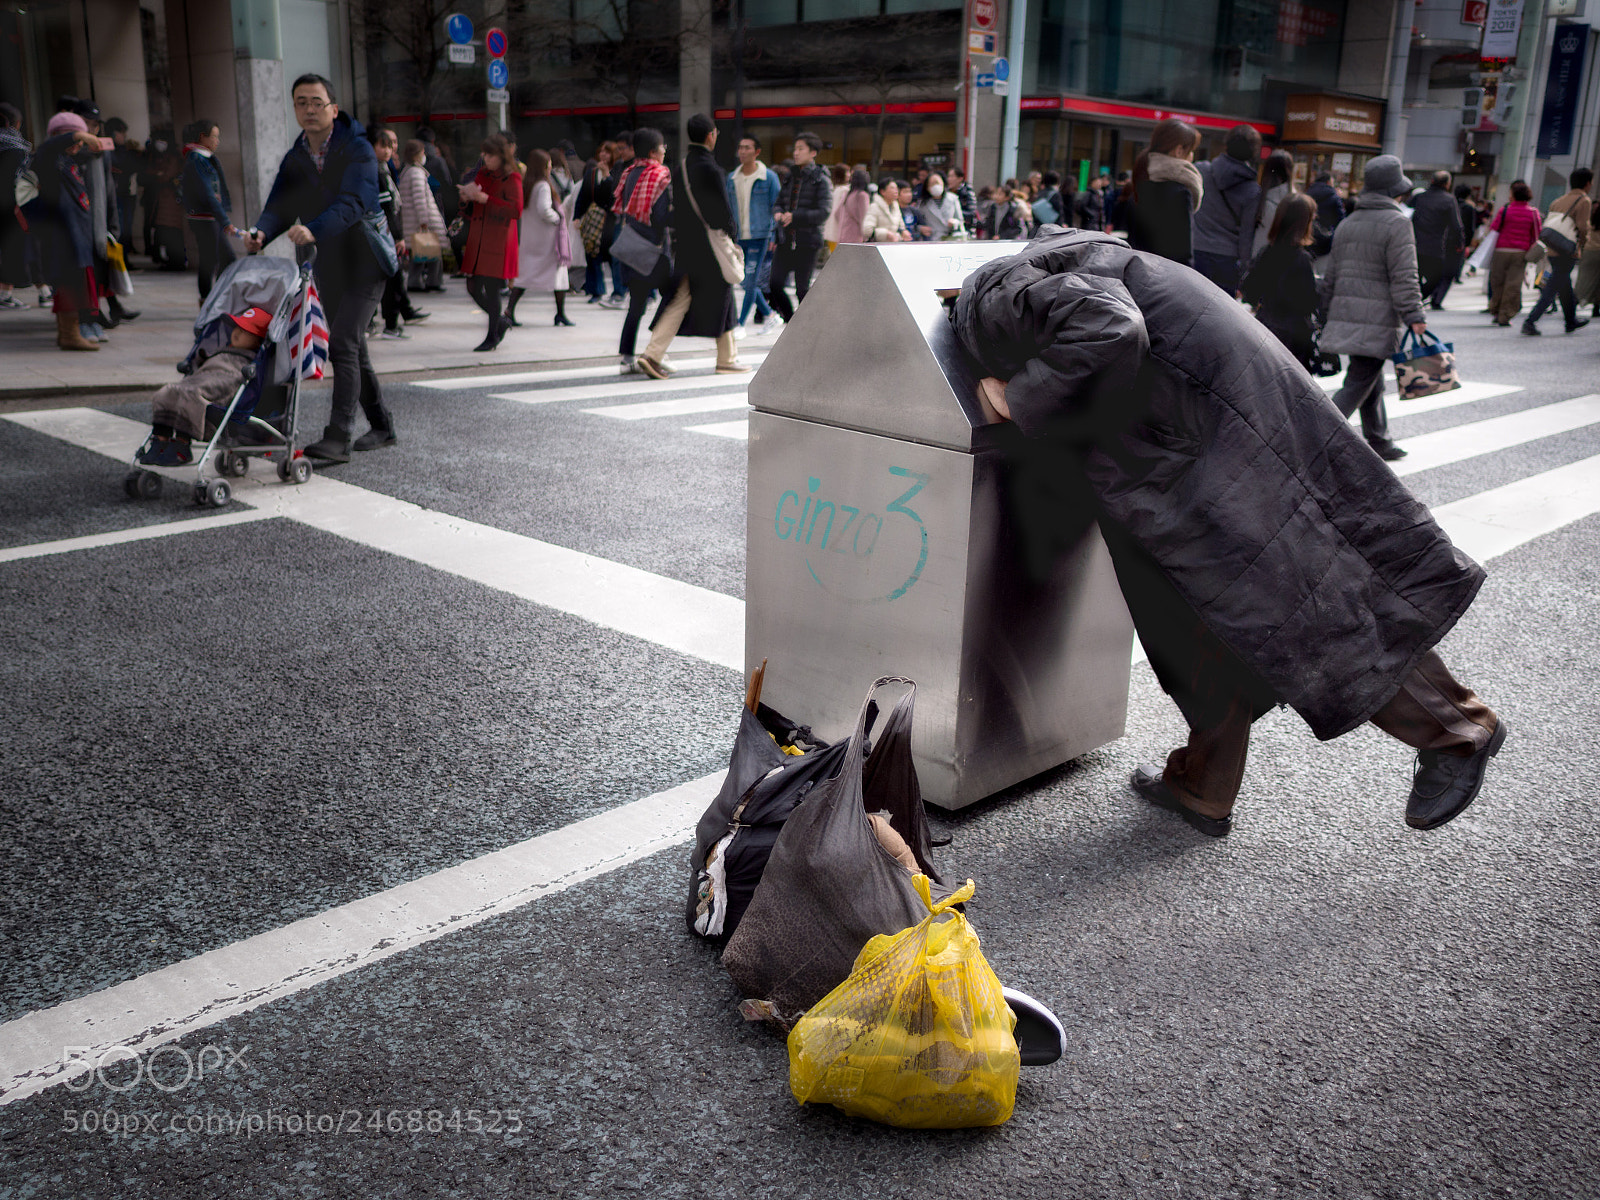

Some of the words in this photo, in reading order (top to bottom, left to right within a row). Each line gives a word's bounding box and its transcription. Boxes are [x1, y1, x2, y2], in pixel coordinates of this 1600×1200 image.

[1494, 9, 1518, 17] TOKYO
[1491, 20, 1516, 30] 2018
[493, 65, 502, 83] P
[774, 475, 884, 557] Ginza
